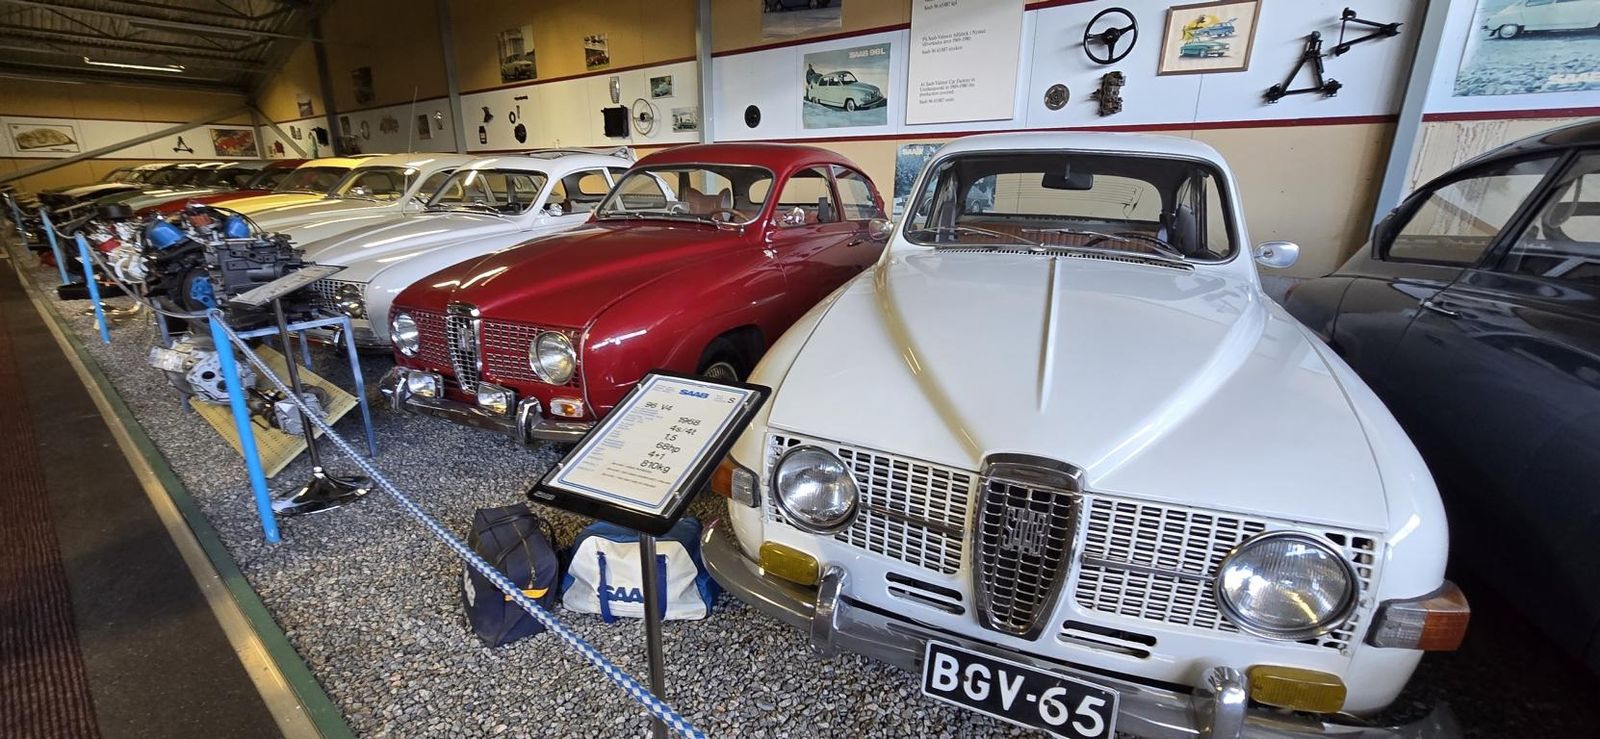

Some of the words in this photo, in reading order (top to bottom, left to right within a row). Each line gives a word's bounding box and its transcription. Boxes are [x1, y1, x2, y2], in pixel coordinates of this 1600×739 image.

[678, 389, 710, 399] SAAB
[644, 401, 658, 409] 96
[660, 403, 674, 412] V4
[678, 416, 701, 426] 1968
[655, 441, 681, 454] 68hp
[647, 451, 665, 460] 4+1
[640, 459, 671, 474] 810kg
[596, 584, 646, 604] SAA
[931, 651, 1107, 738] BGV-65
